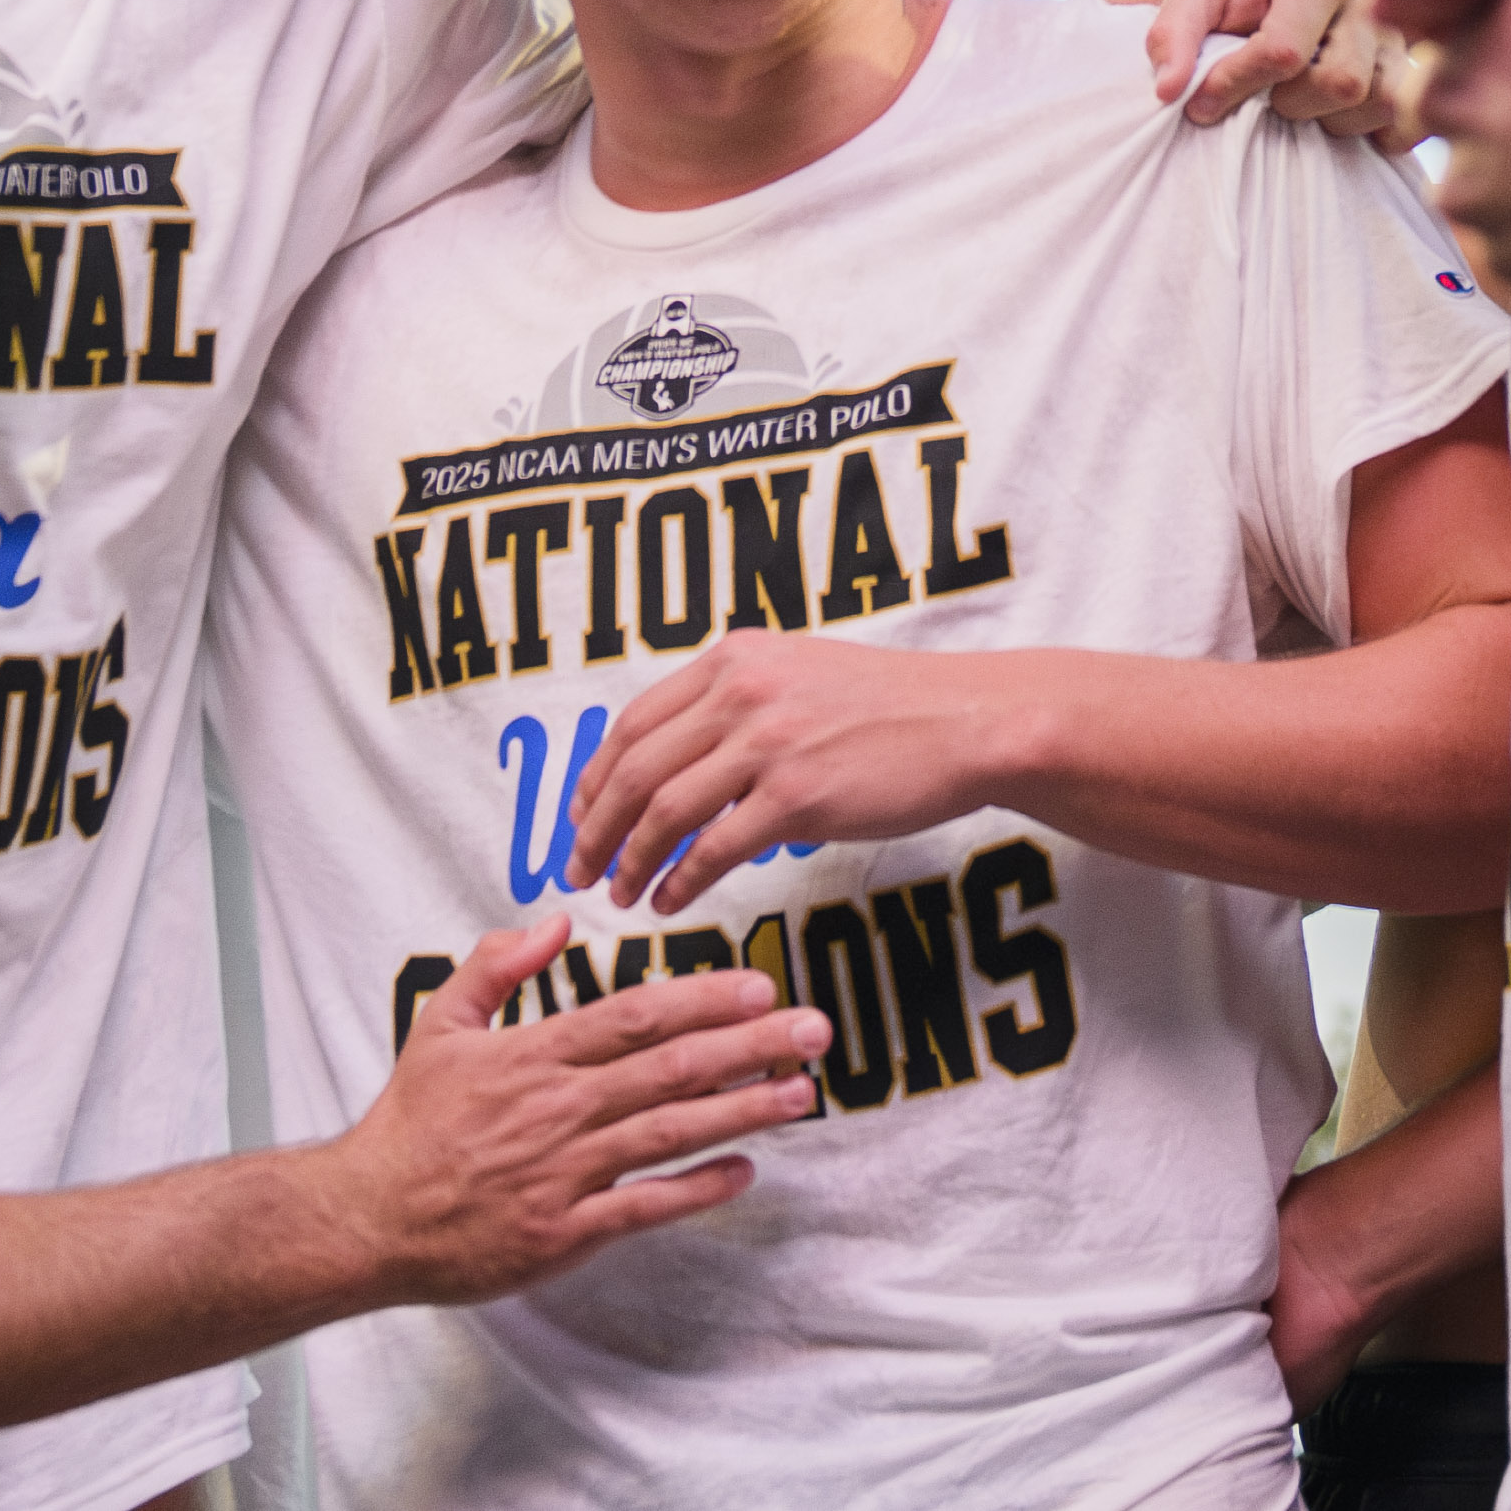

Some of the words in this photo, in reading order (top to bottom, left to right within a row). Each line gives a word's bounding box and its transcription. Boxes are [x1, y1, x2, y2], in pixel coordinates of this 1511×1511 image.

[597, 349, 738, 386] CHAMPIONSHIP
[420, 459, 491, 500] 2025
[495, 443, 583, 486] NCAA
[591, 432, 699, 476] MEN'S
[706, 412, 817, 459] WATER
[829, 383, 913, 432] POLO
[372, 431, 1015, 706] NATIONAL
